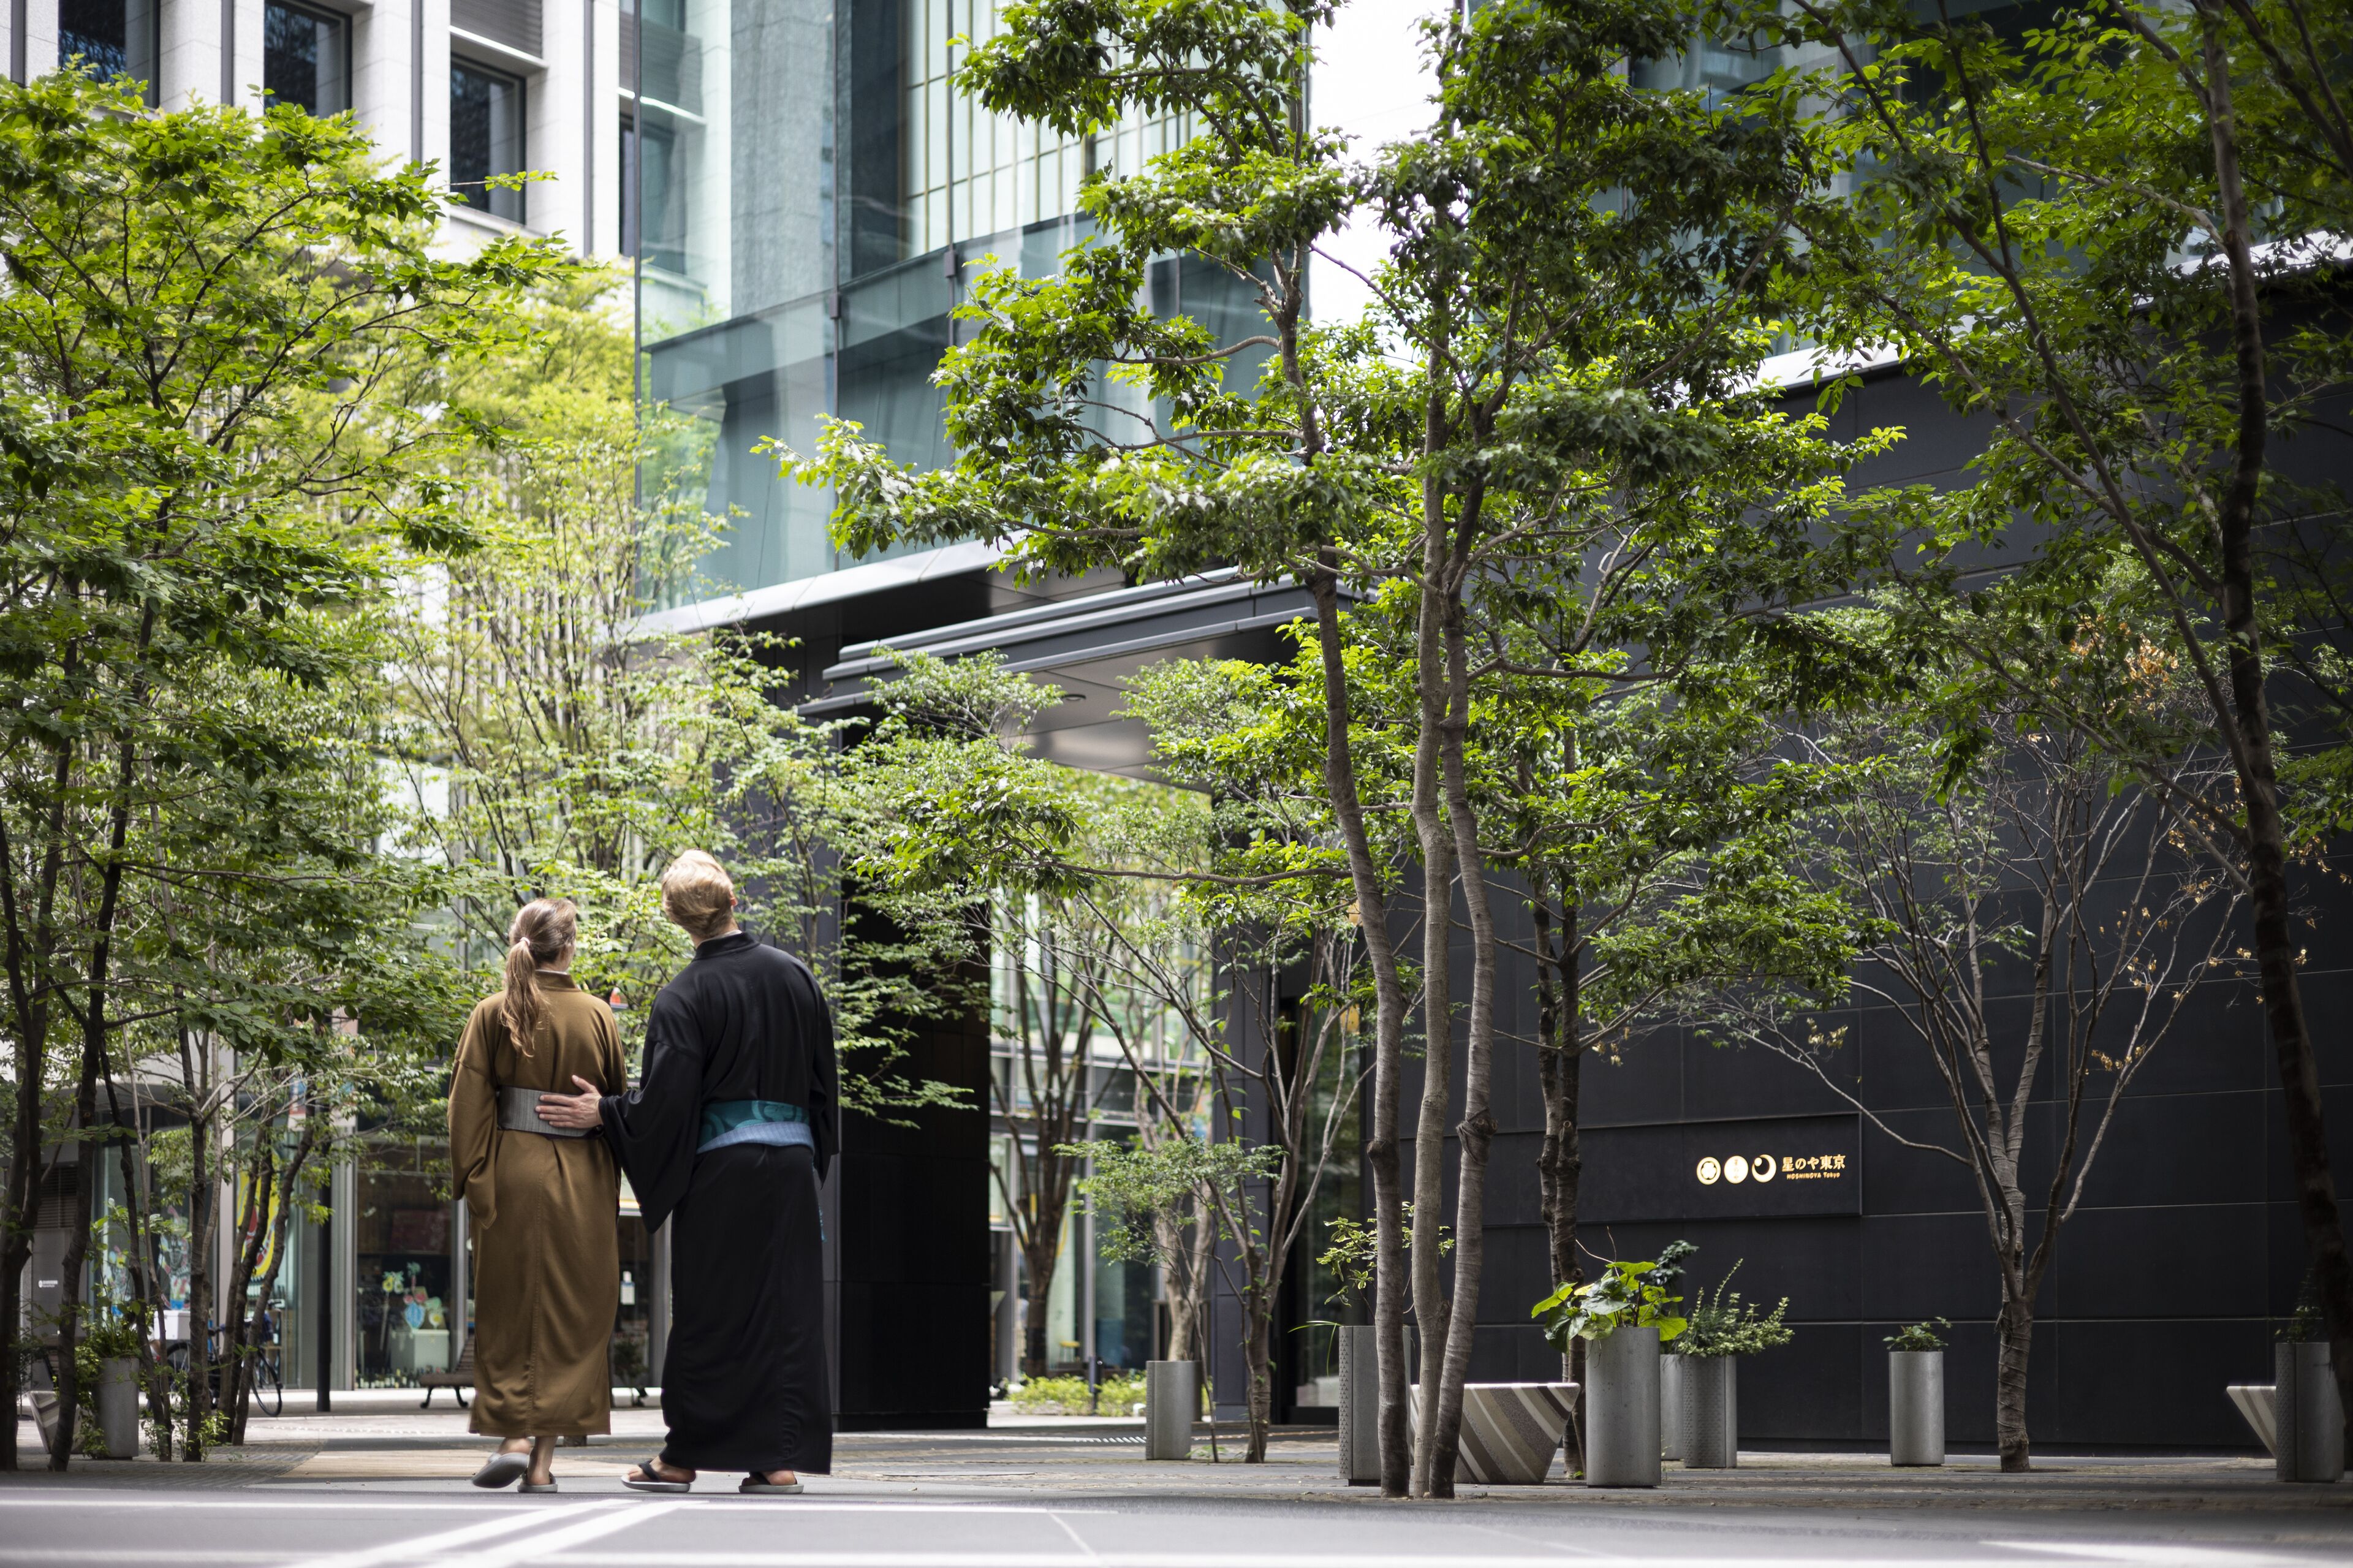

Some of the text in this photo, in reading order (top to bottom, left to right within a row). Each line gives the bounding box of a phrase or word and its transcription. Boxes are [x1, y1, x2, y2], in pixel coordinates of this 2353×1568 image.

[1782, 1154, 1846, 1172] 星のや東京
